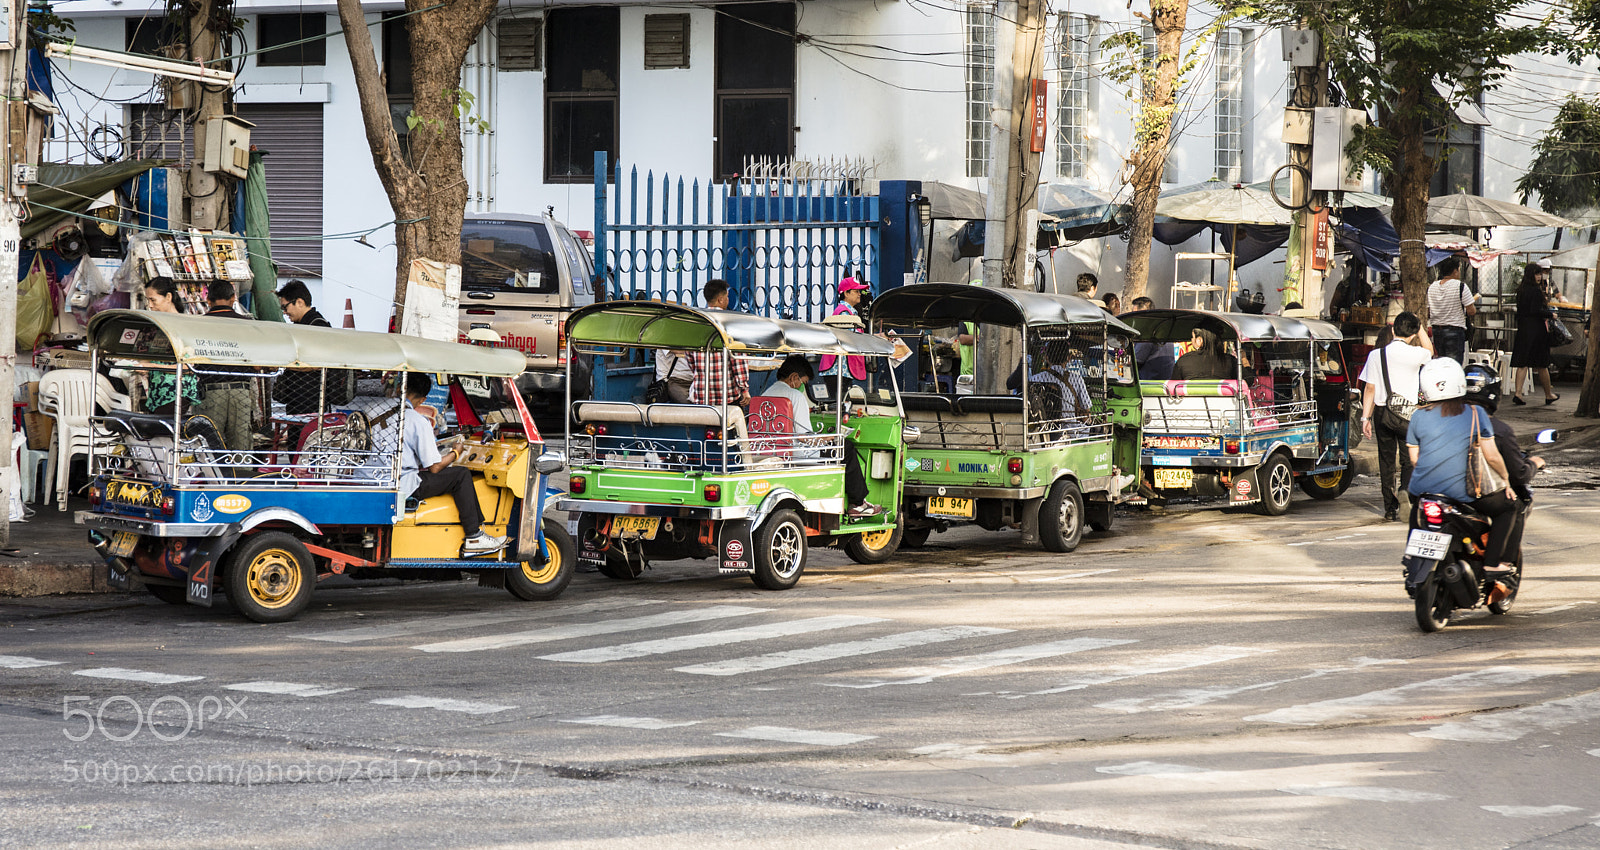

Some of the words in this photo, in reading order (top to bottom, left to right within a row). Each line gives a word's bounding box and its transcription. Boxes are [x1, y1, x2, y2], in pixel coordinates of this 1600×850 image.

[1037, 95, 1045, 106] SY
[1036, 107, 1045, 118] 26
[1318, 221, 1327, 231] SY
[1318, 232, 1326, 241] 26
[3, 240, 16, 252] 90
[1149, 438, 1204, 448] THAILAND
[958, 463, 989, 474] MONIKA
[950, 498, 969, 510] 947
[632, 518, 657, 529] 6863
